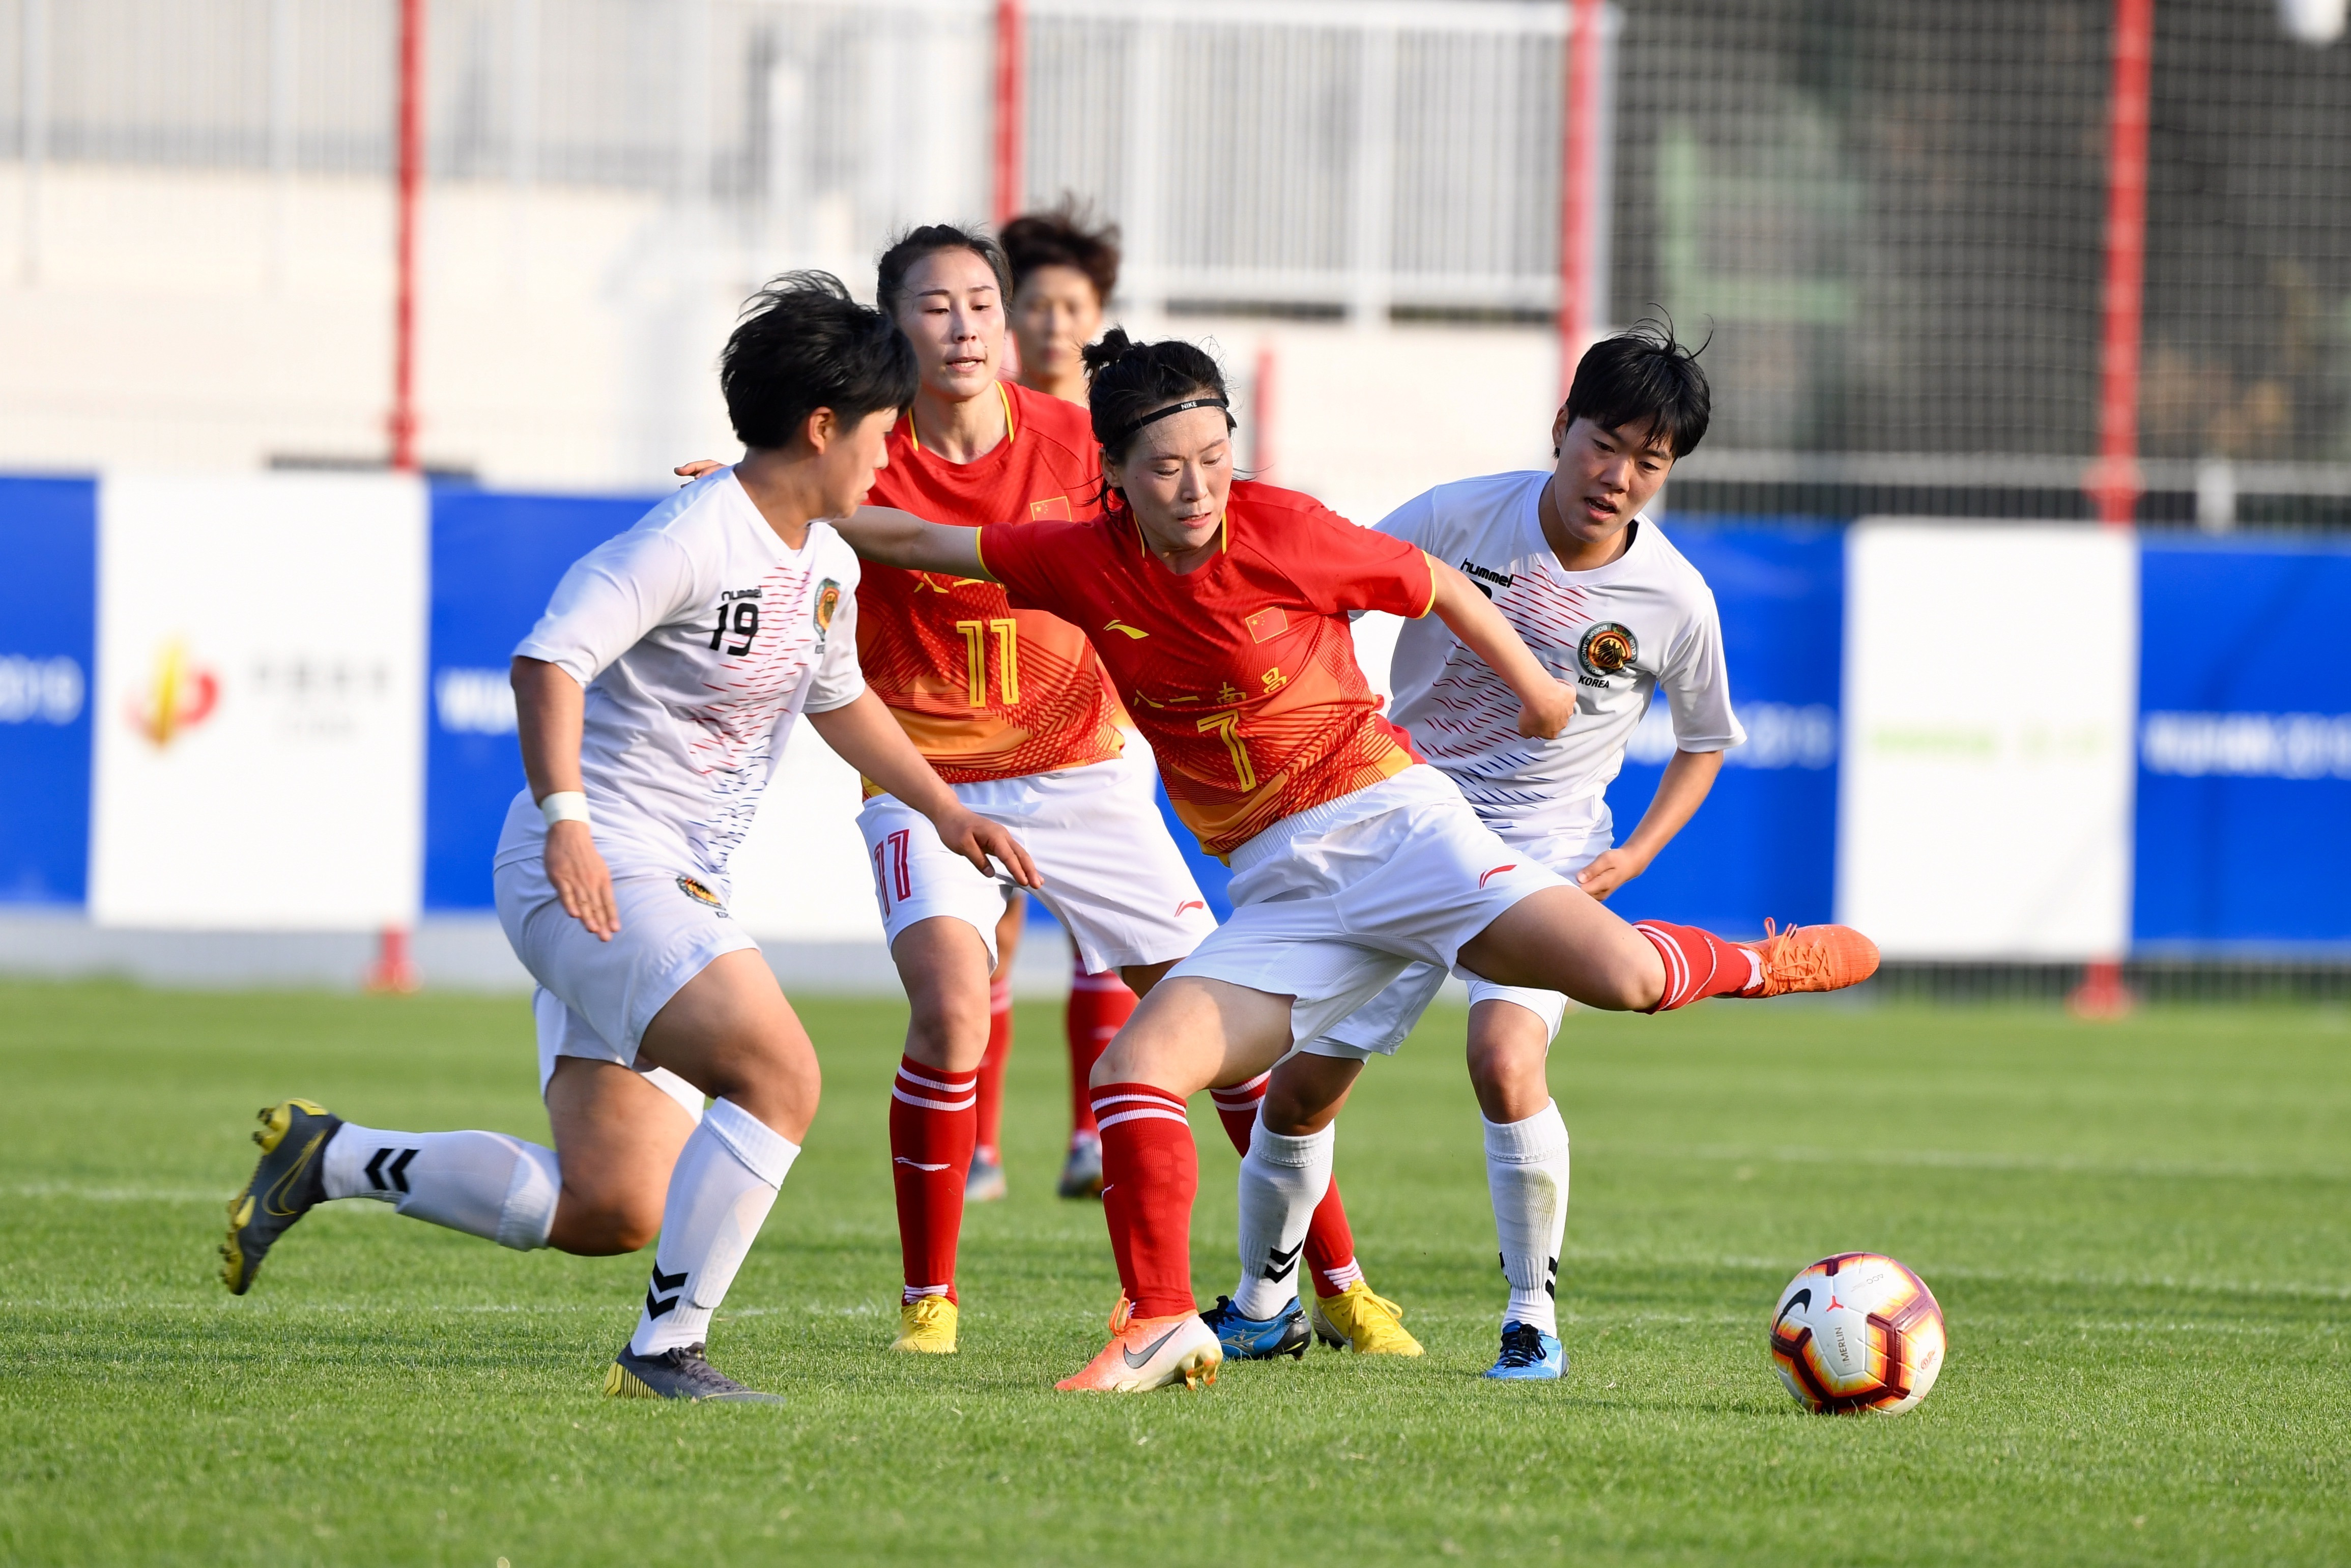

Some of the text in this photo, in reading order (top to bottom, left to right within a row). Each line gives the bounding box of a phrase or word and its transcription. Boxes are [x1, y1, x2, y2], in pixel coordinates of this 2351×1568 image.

[1181, 401, 1197, 410] NIKE
[1460, 557, 1514, 588] hummel
[709, 602, 759, 657] 19
[1587, 624, 1608, 640] BOEUN
[956, 618, 1019, 707] 11
[1578, 675, 1610, 689] KOREA
[1196, 709, 1256, 792] 7
[873, 829, 911, 919] 11
[1834, 1327, 1850, 1362] MERLIN
